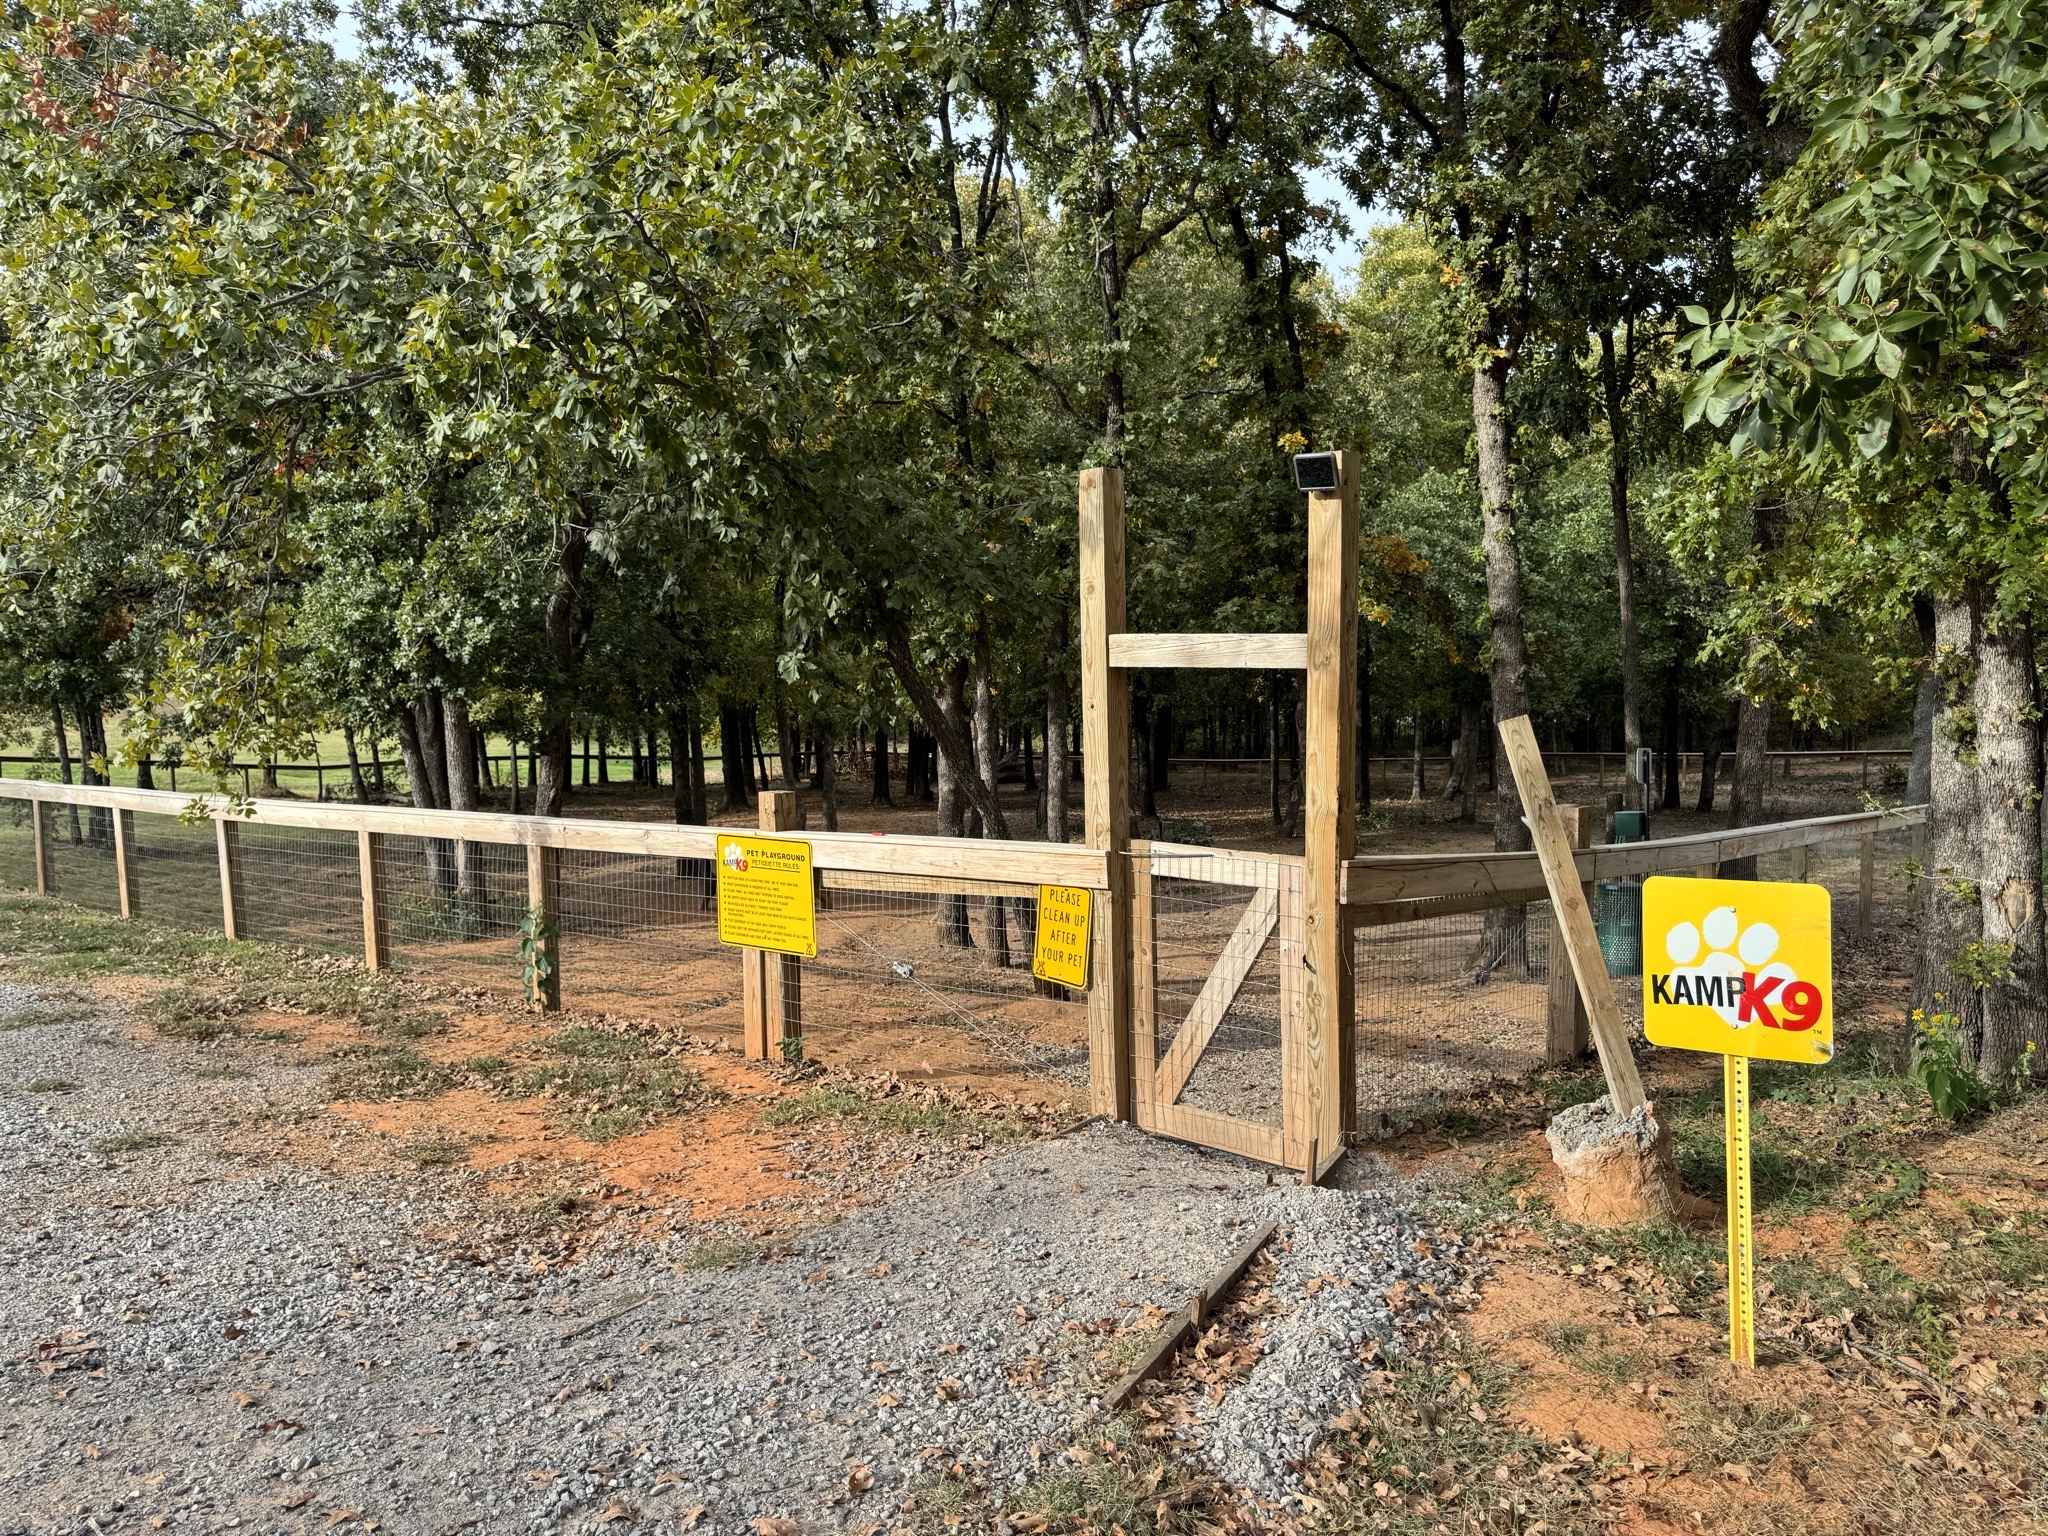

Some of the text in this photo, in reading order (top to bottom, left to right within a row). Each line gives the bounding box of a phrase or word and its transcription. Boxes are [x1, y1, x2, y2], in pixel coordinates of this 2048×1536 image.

[746, 849, 806, 862] PET PLAYGROUND
[752, 859, 801, 870] PETIQUETTE RULES:
[1049, 888, 1081, 907] PLEASE
[1043, 907, 1085, 928] CLEAN UP
[1050, 928, 1077, 946] AFTER
[1041, 946, 1083, 968] YOUR PET
